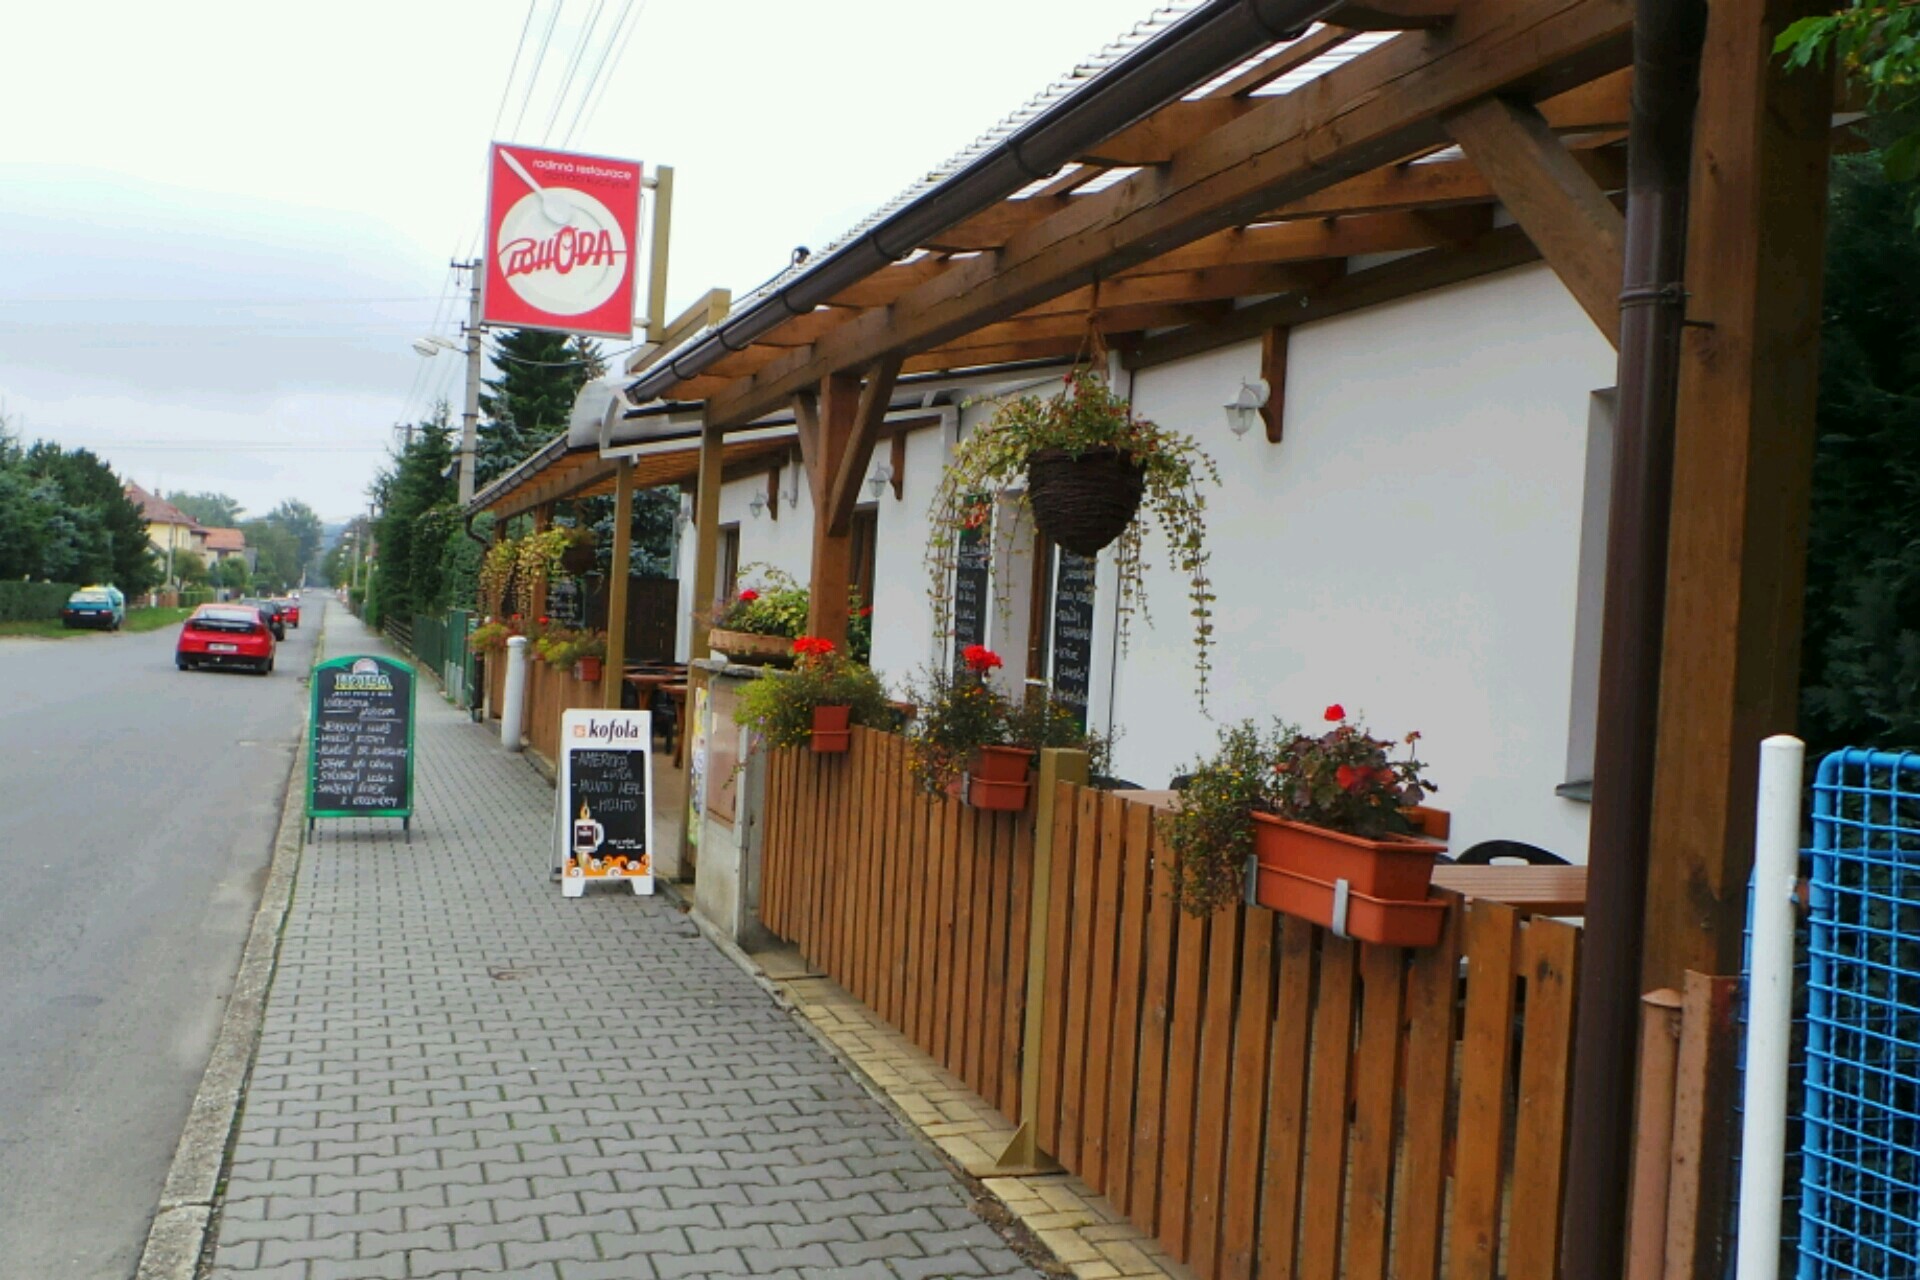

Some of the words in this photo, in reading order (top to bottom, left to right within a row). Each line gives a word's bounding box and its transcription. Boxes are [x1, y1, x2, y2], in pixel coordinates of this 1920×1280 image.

[532, 159, 574, 173] rodinná
[576, 165, 632, 181] restaurace
[589, 718, 639, 744] kofola
